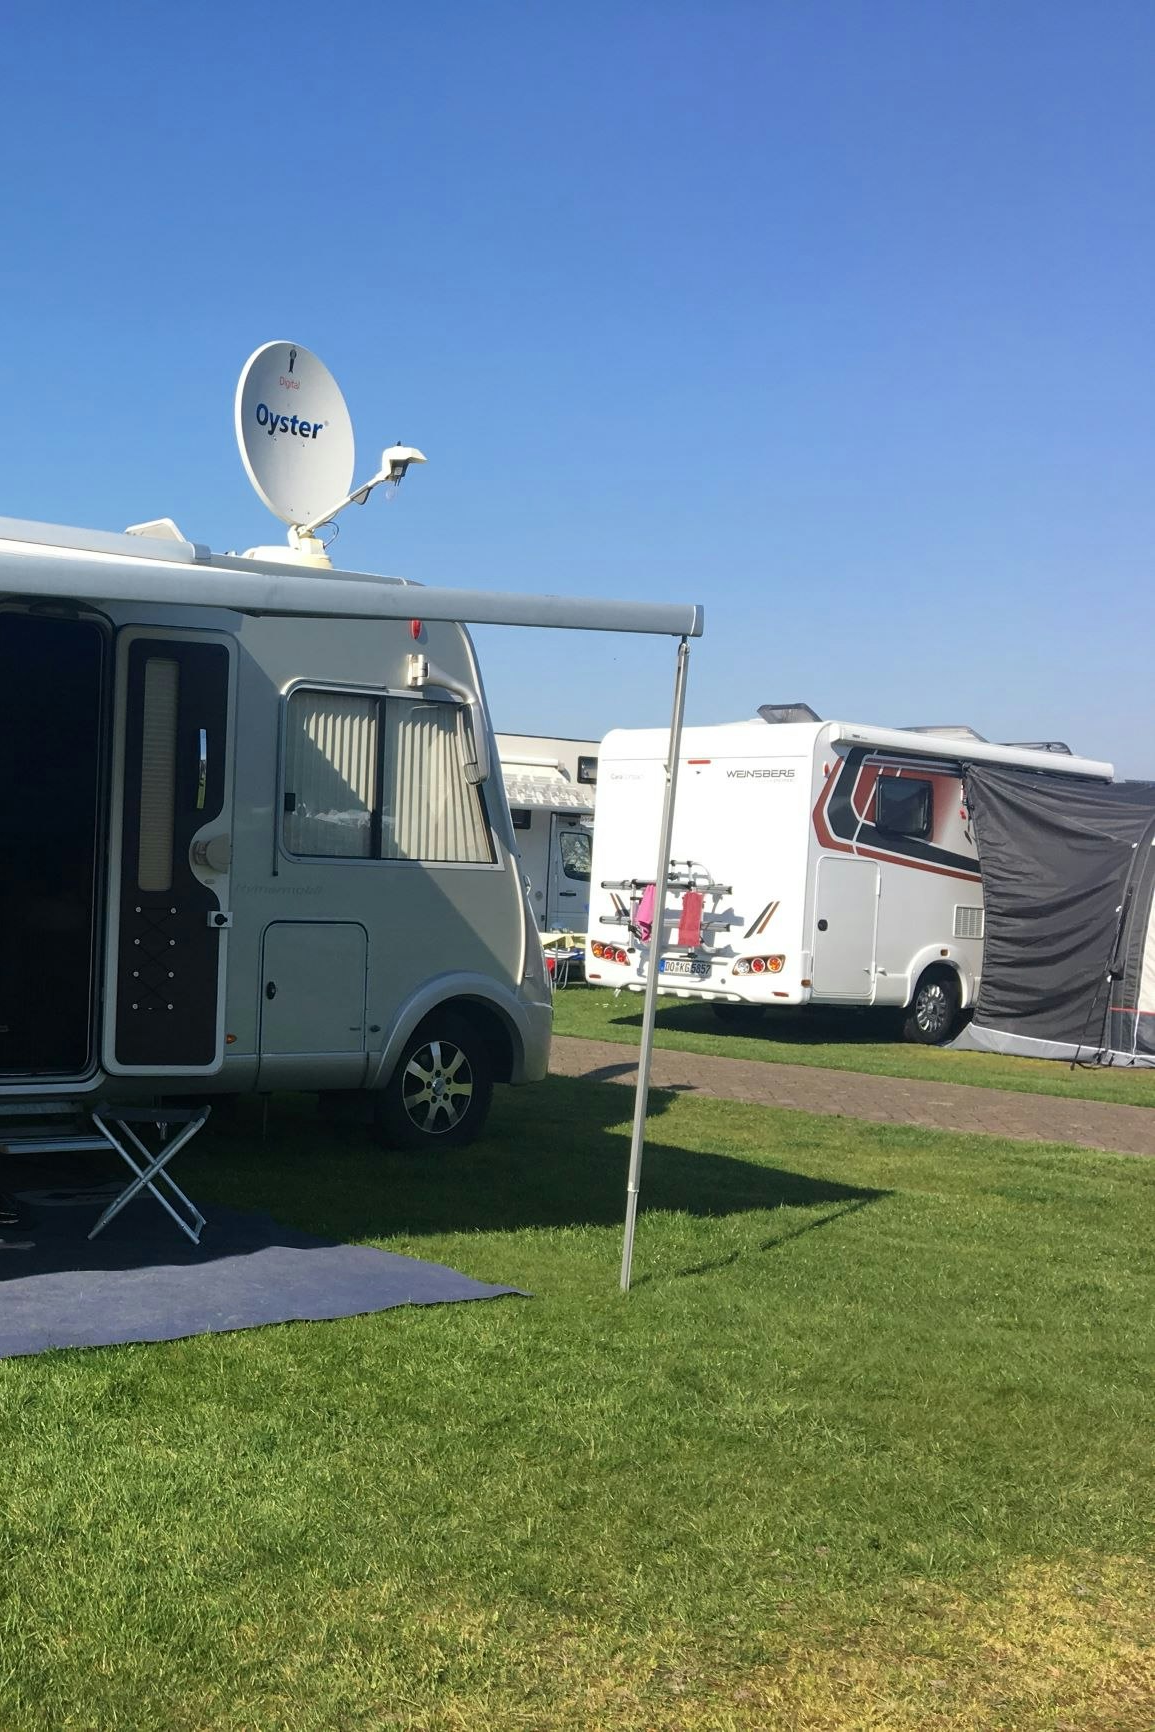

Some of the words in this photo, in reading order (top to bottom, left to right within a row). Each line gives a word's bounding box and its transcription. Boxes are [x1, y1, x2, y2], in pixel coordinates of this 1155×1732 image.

[279, 376, 301, 390] Digital
[255, 403, 323, 439] Oyster
[726, 769, 795, 779] WEINSBERG
